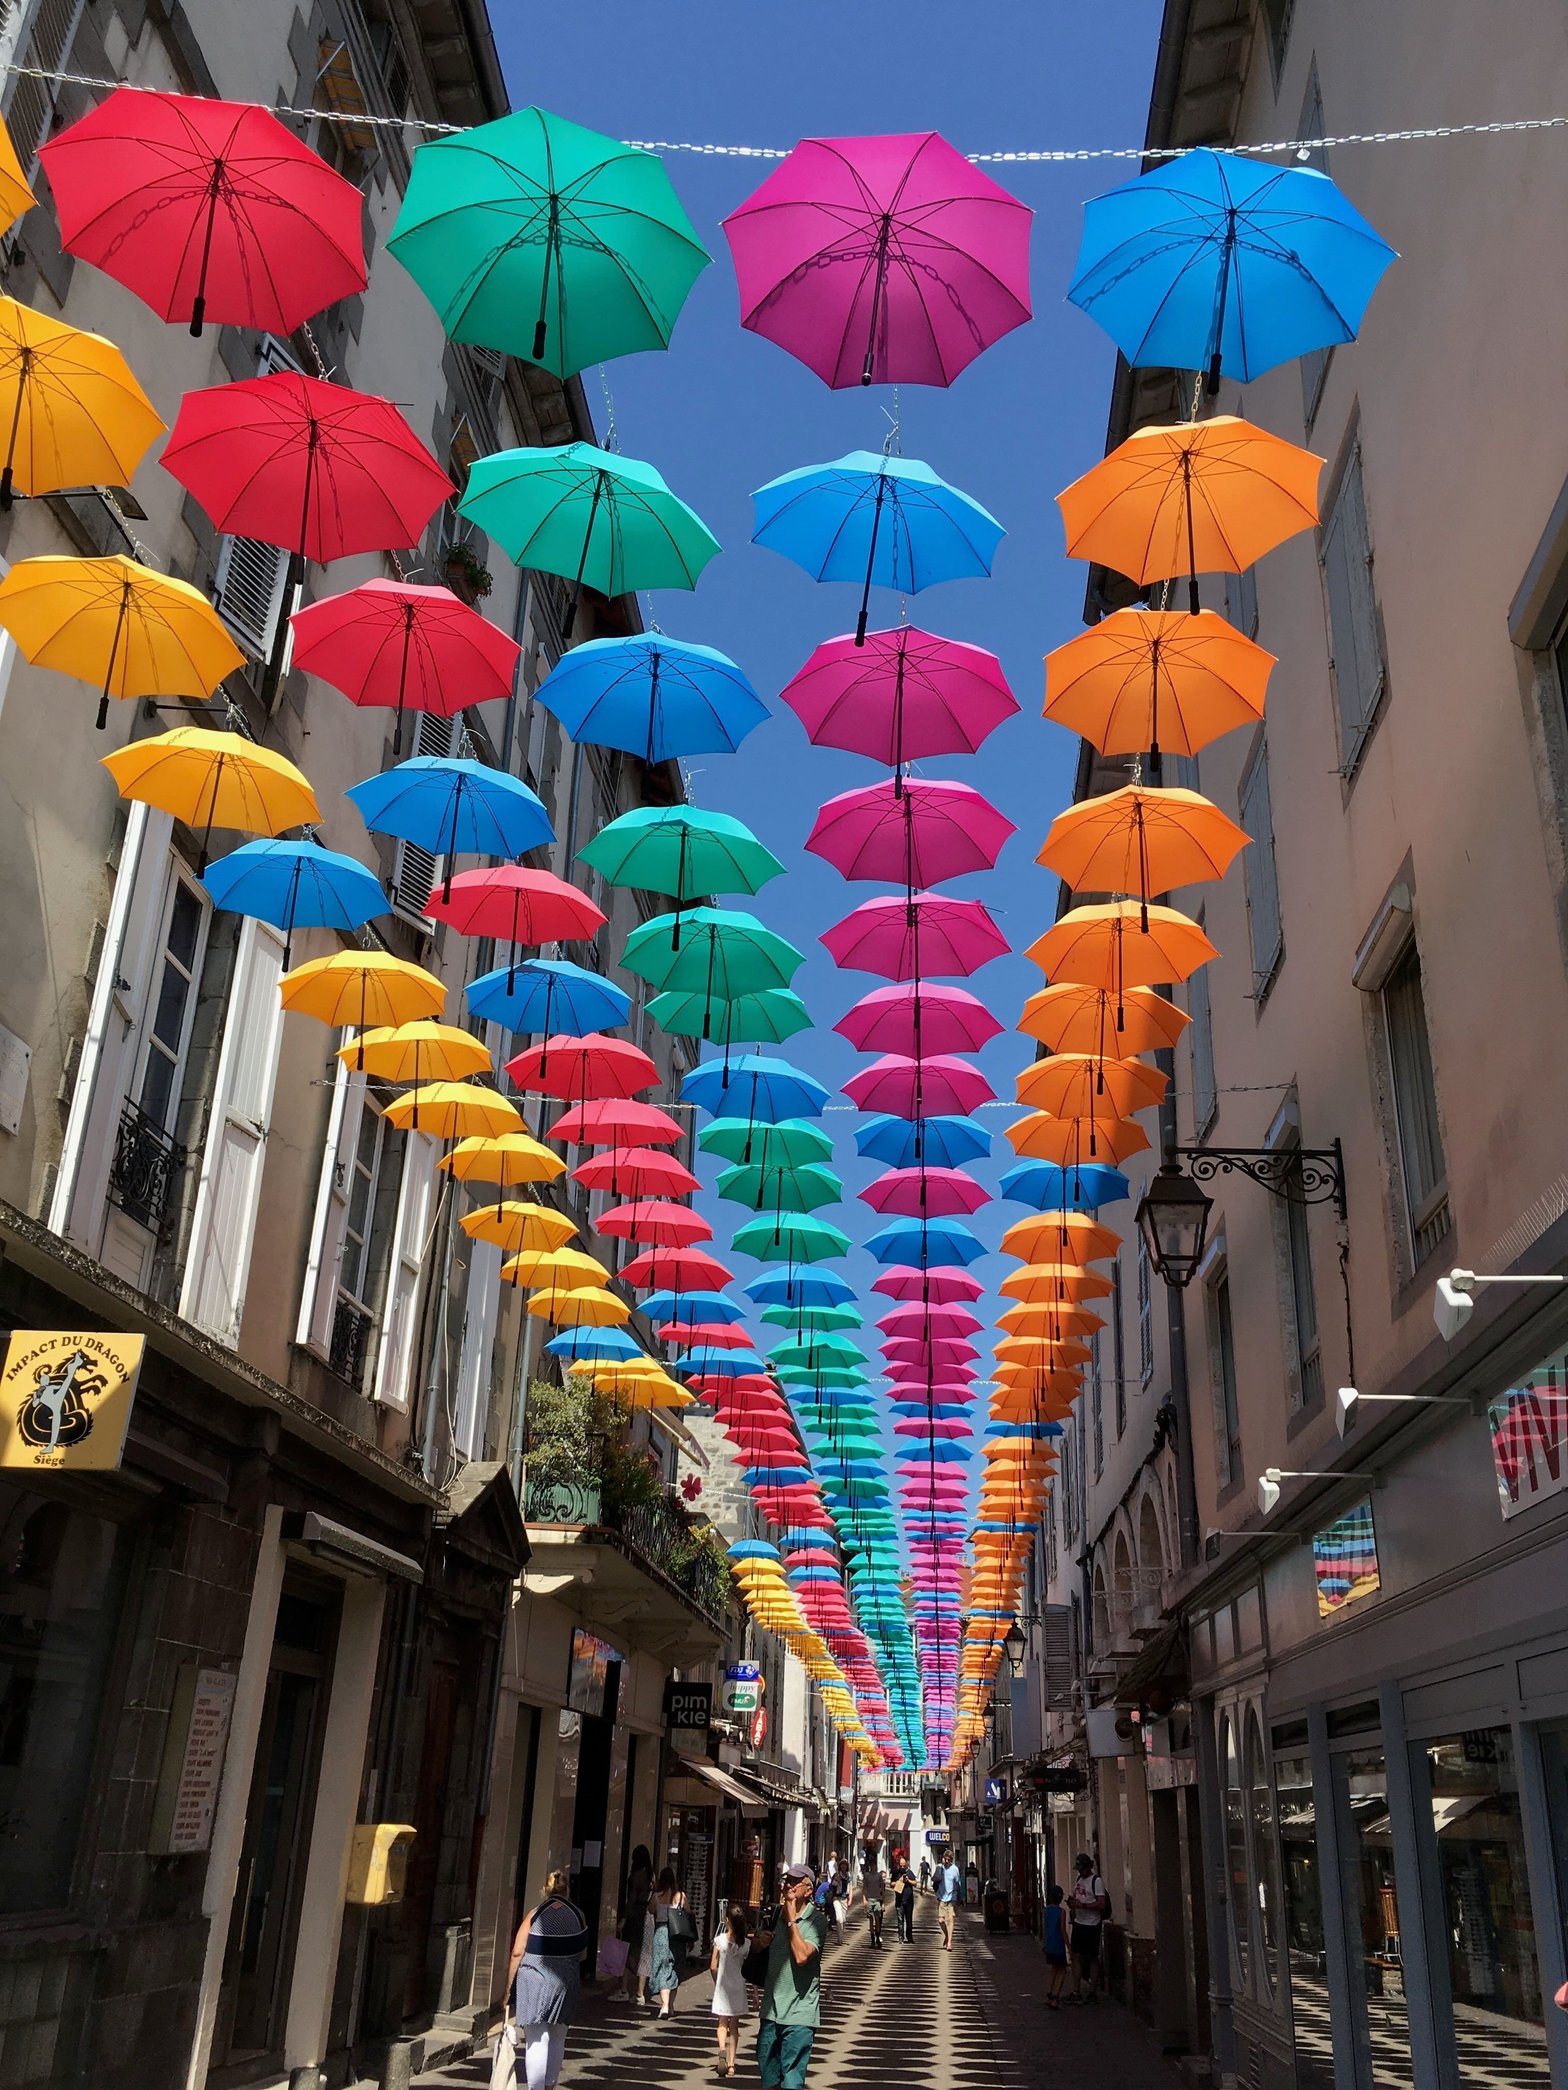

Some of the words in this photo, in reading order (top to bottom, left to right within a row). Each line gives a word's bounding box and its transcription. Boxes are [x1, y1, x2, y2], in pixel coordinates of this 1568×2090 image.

[5, 1339, 58, 1382] IMPACT
[61, 1335, 83, 1347] DU
[85, 1337, 130, 1384] DRAGON
[1490, 1355, 1568, 1502] VN
[33, 1454, 65, 1466] Siège
[671, 1695, 707, 1711] pim
[677, 1711, 707, 1724] kie
[754, 1710, 764, 1745] TABAC
